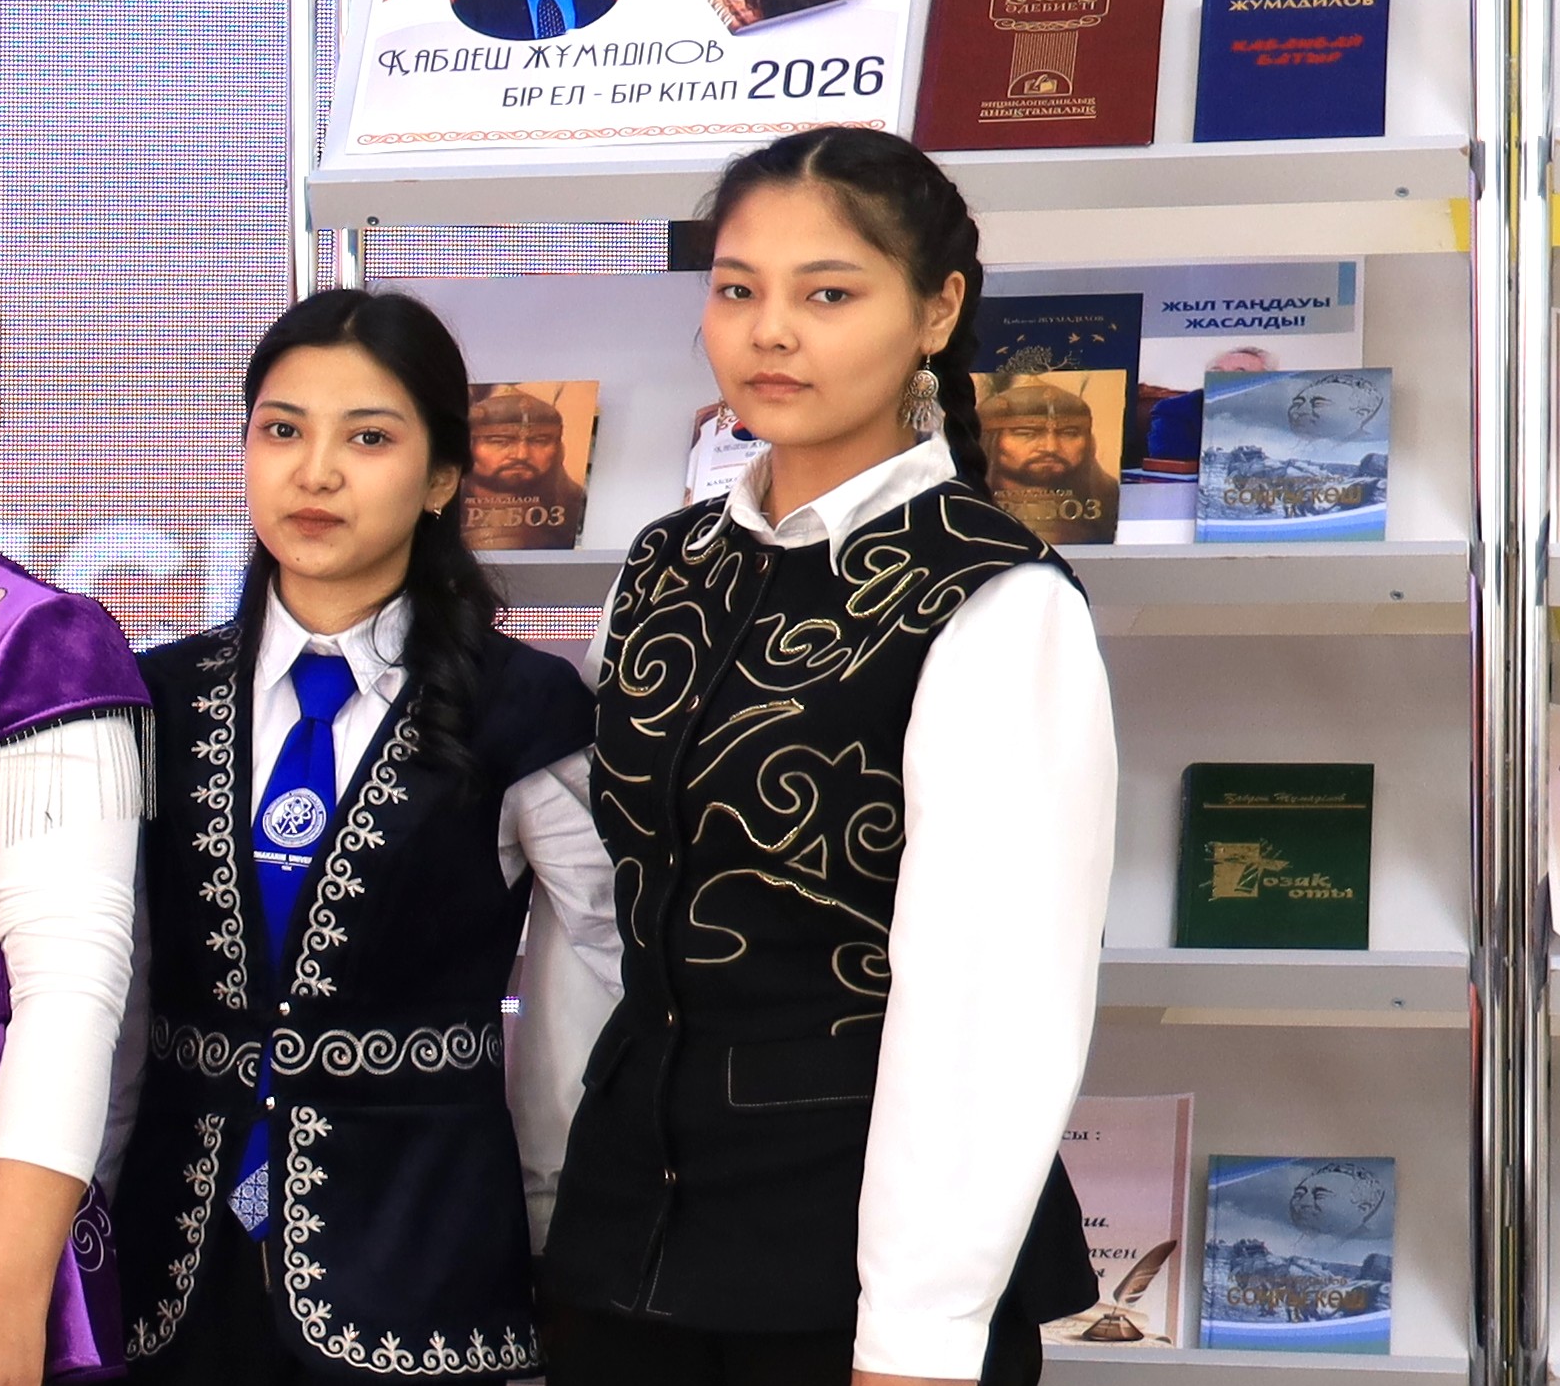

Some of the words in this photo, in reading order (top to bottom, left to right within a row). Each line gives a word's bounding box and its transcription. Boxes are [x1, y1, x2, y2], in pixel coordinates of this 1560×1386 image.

[378, 45, 511, 76] ҚАБДЕШ
[748, 56, 885, 99] 2026
[502, 87, 543, 108] БІР
[550, 85, 586, 106] ЕЛ
[611, 83, 652, 104] БІР
[659, 80, 738, 102] КІТАП
[1161, 299, 1216, 312] ЖЫЛ
[1222, 297, 1331, 312] ТАҢДАУЫ
[1185, 315, 1306, 331] ЖАСАЛДЫ!
